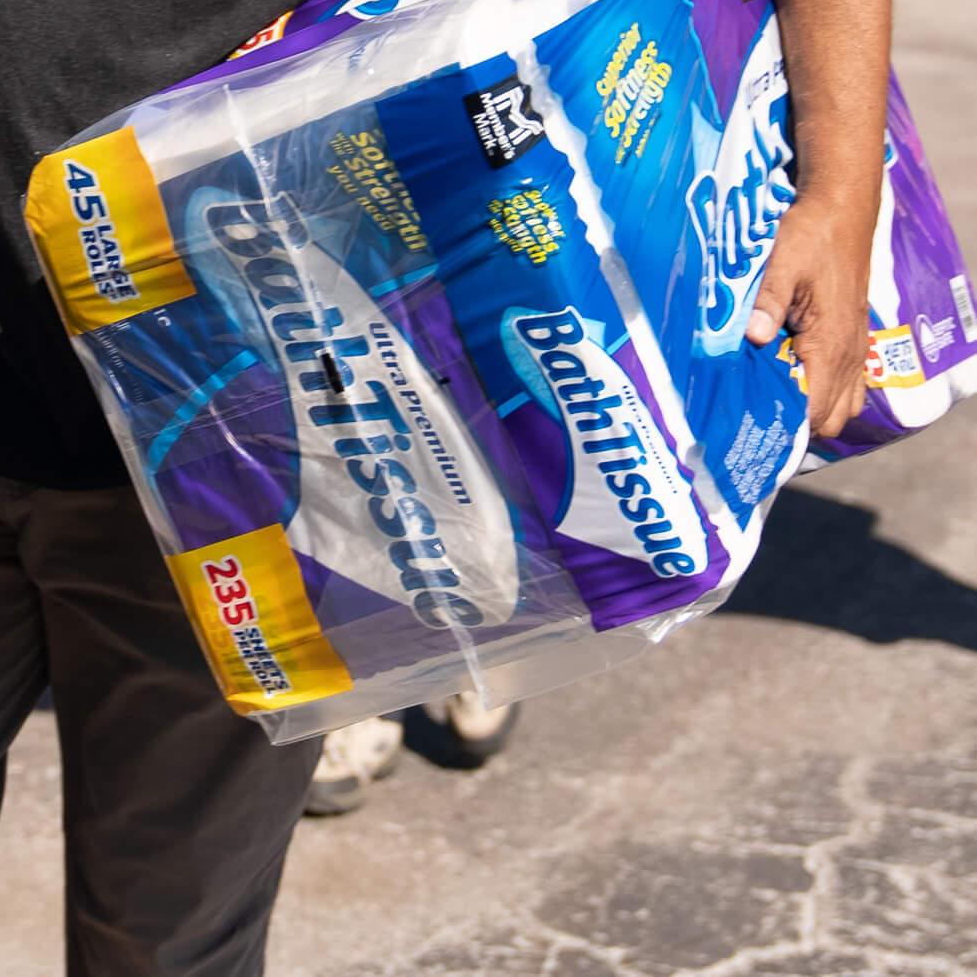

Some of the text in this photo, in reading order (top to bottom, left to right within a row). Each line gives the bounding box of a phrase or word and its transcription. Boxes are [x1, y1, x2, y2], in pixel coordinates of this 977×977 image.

[472, 112, 498, 152] Mark
[480, 91, 516, 160] Member's
[66, 161, 107, 222] 45
[96, 224, 137, 297] LARGE
[82, 230, 113, 297] ROLLS
[368, 322, 472, 506] Ultra Premium
[205, 558, 290, 692] 235 SHEETS
